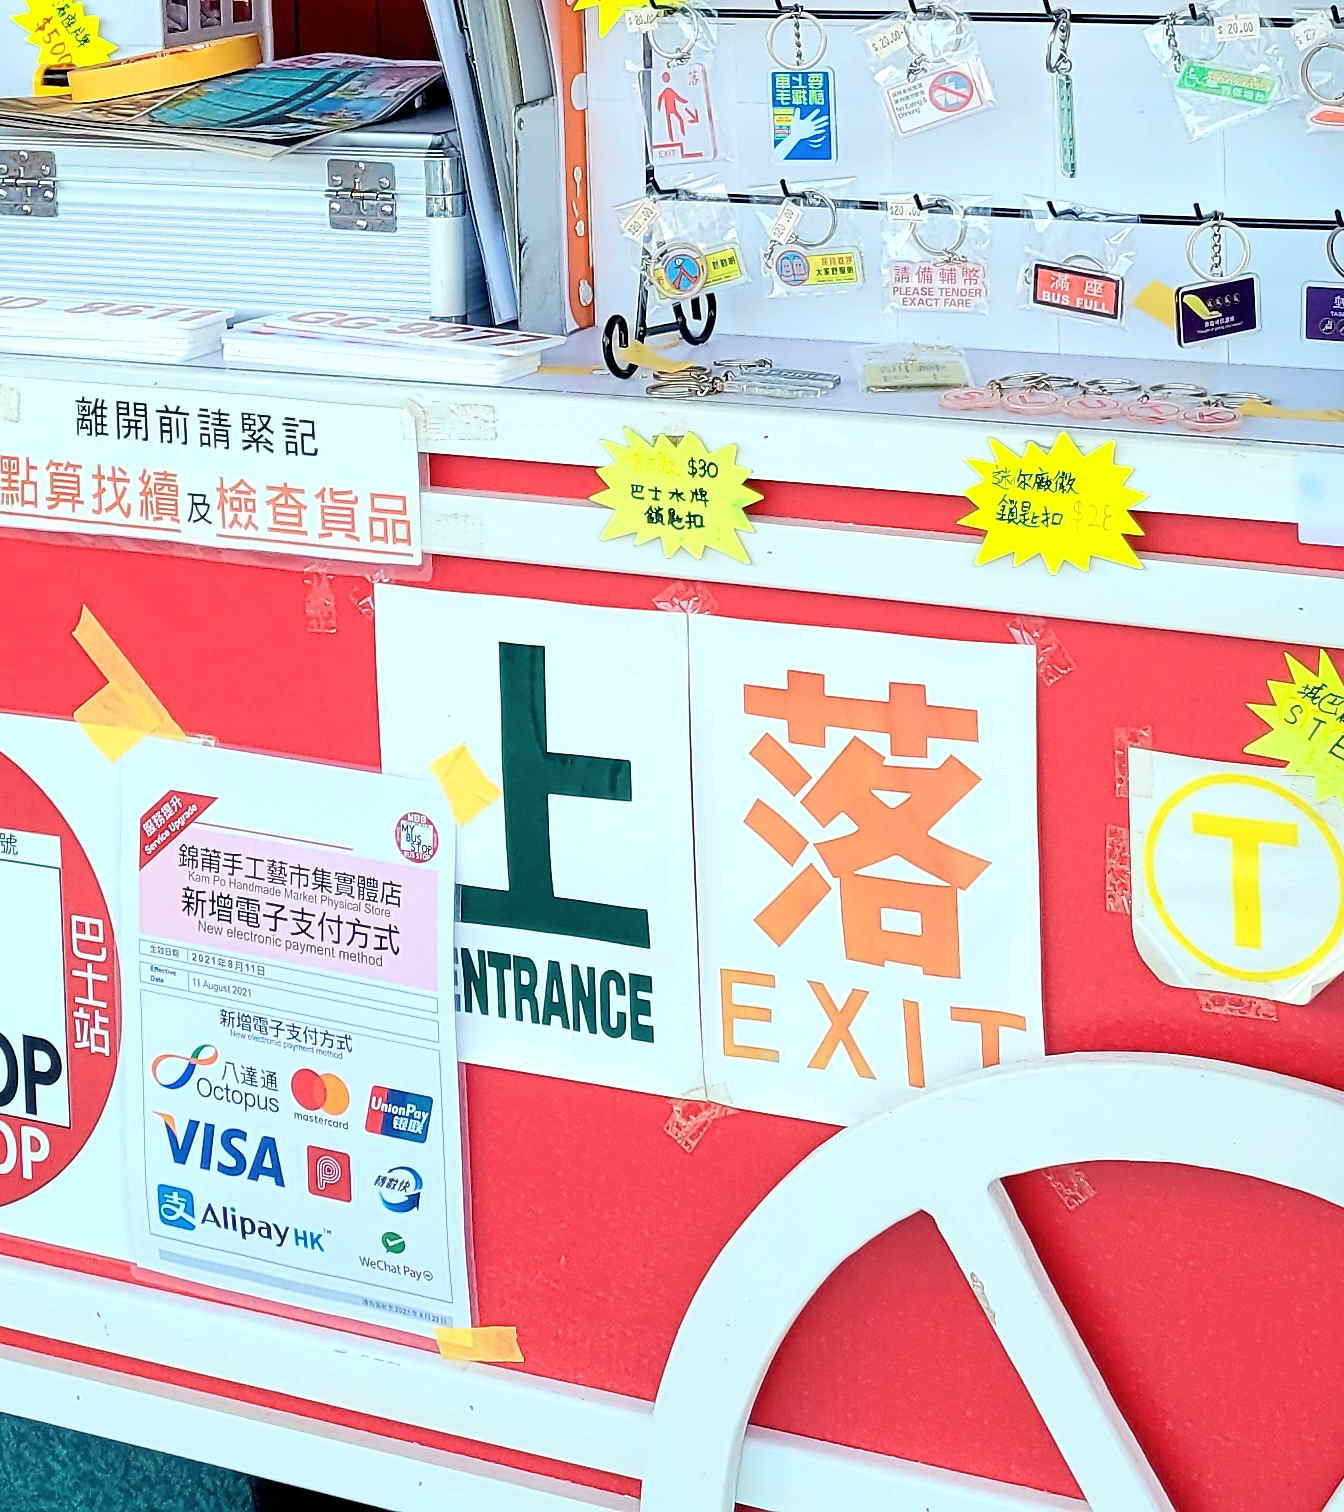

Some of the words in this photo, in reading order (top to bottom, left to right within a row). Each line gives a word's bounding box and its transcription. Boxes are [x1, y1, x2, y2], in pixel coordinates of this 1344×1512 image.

[891, 265, 981, 285] 請備輔幣
[892, 286, 935, 298] PLEASE
[938, 287, 983, 299] TENDER
[901, 296, 941, 308] EXACT
[943, 297, 972, 308] FARE
[1041, 291, 1071, 306] BUS
[1076, 296, 1110, 314] FULL
[74, 396, 319, 458] 離開前請緊記
[687, 457, 719, 481] $30
[0, 454, 412, 547] 點算找續及檢查貨品
[456, 641, 651, 949] 上
[743, 669, 992, 979] 落
[187, 871, 211, 886] Kam
[212, 875, 227, 888] Po
[229, 877, 282, 899] Handmade
[284, 887, 318, 906] Market
[320, 894, 362, 914] Physical
[364, 902, 392, 918] Store
[1191, 810, 1299, 950] T
[181, 884, 400, 956] 新增電子支付方式
[197, 919, 224, 936] New
[226, 926, 282, 949] electronic
[284, 937, 336, 962] payment
[338, 948, 384, 968] method
[70, 914, 111, 1057] 巴士站
[202, 979, 231, 993] August
[232, 985, 252, 998] 2021
[219, 1008, 353, 1053] 新增電子支付方式
[720, 967, 1027, 1088] EXIT
[196, 1077, 281, 1114] Octopus
[221, 1060, 280, 1092] 八達通
[293, 1111, 350, 1130] mastercard
[370, 1095, 430, 1123] UnionPay
[164, 1117, 286, 1188] VISA
[359, 1255, 402, 1276] WeChat
[403, 1265, 423, 1282] Pay
